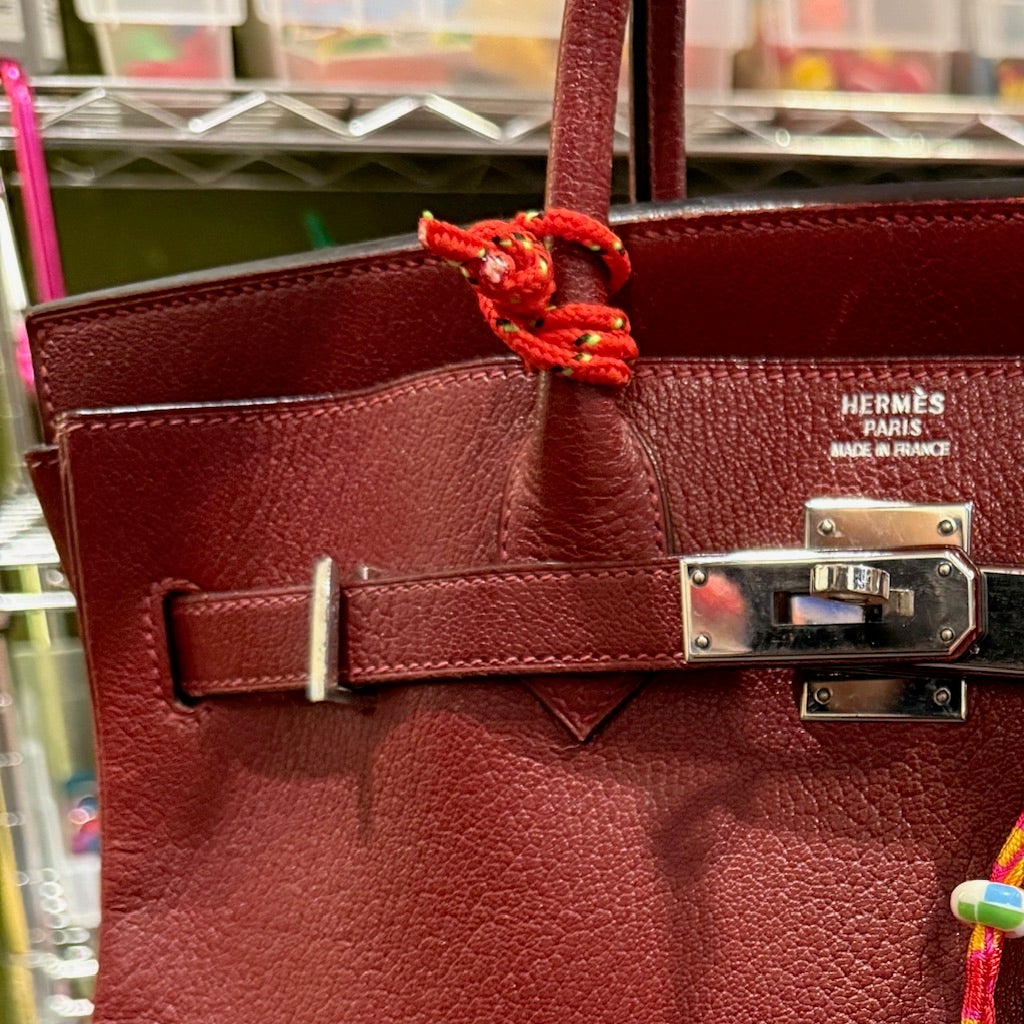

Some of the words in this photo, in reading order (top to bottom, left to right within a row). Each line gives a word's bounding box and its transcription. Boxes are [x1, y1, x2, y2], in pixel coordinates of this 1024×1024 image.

[841, 386, 945, 415] HERMÈS
[863, 418, 922, 437] PARIS
[830, 440, 873, 457] MADE
[875, 441, 890, 457] IN
[893, 440, 950, 457] FRANCE
